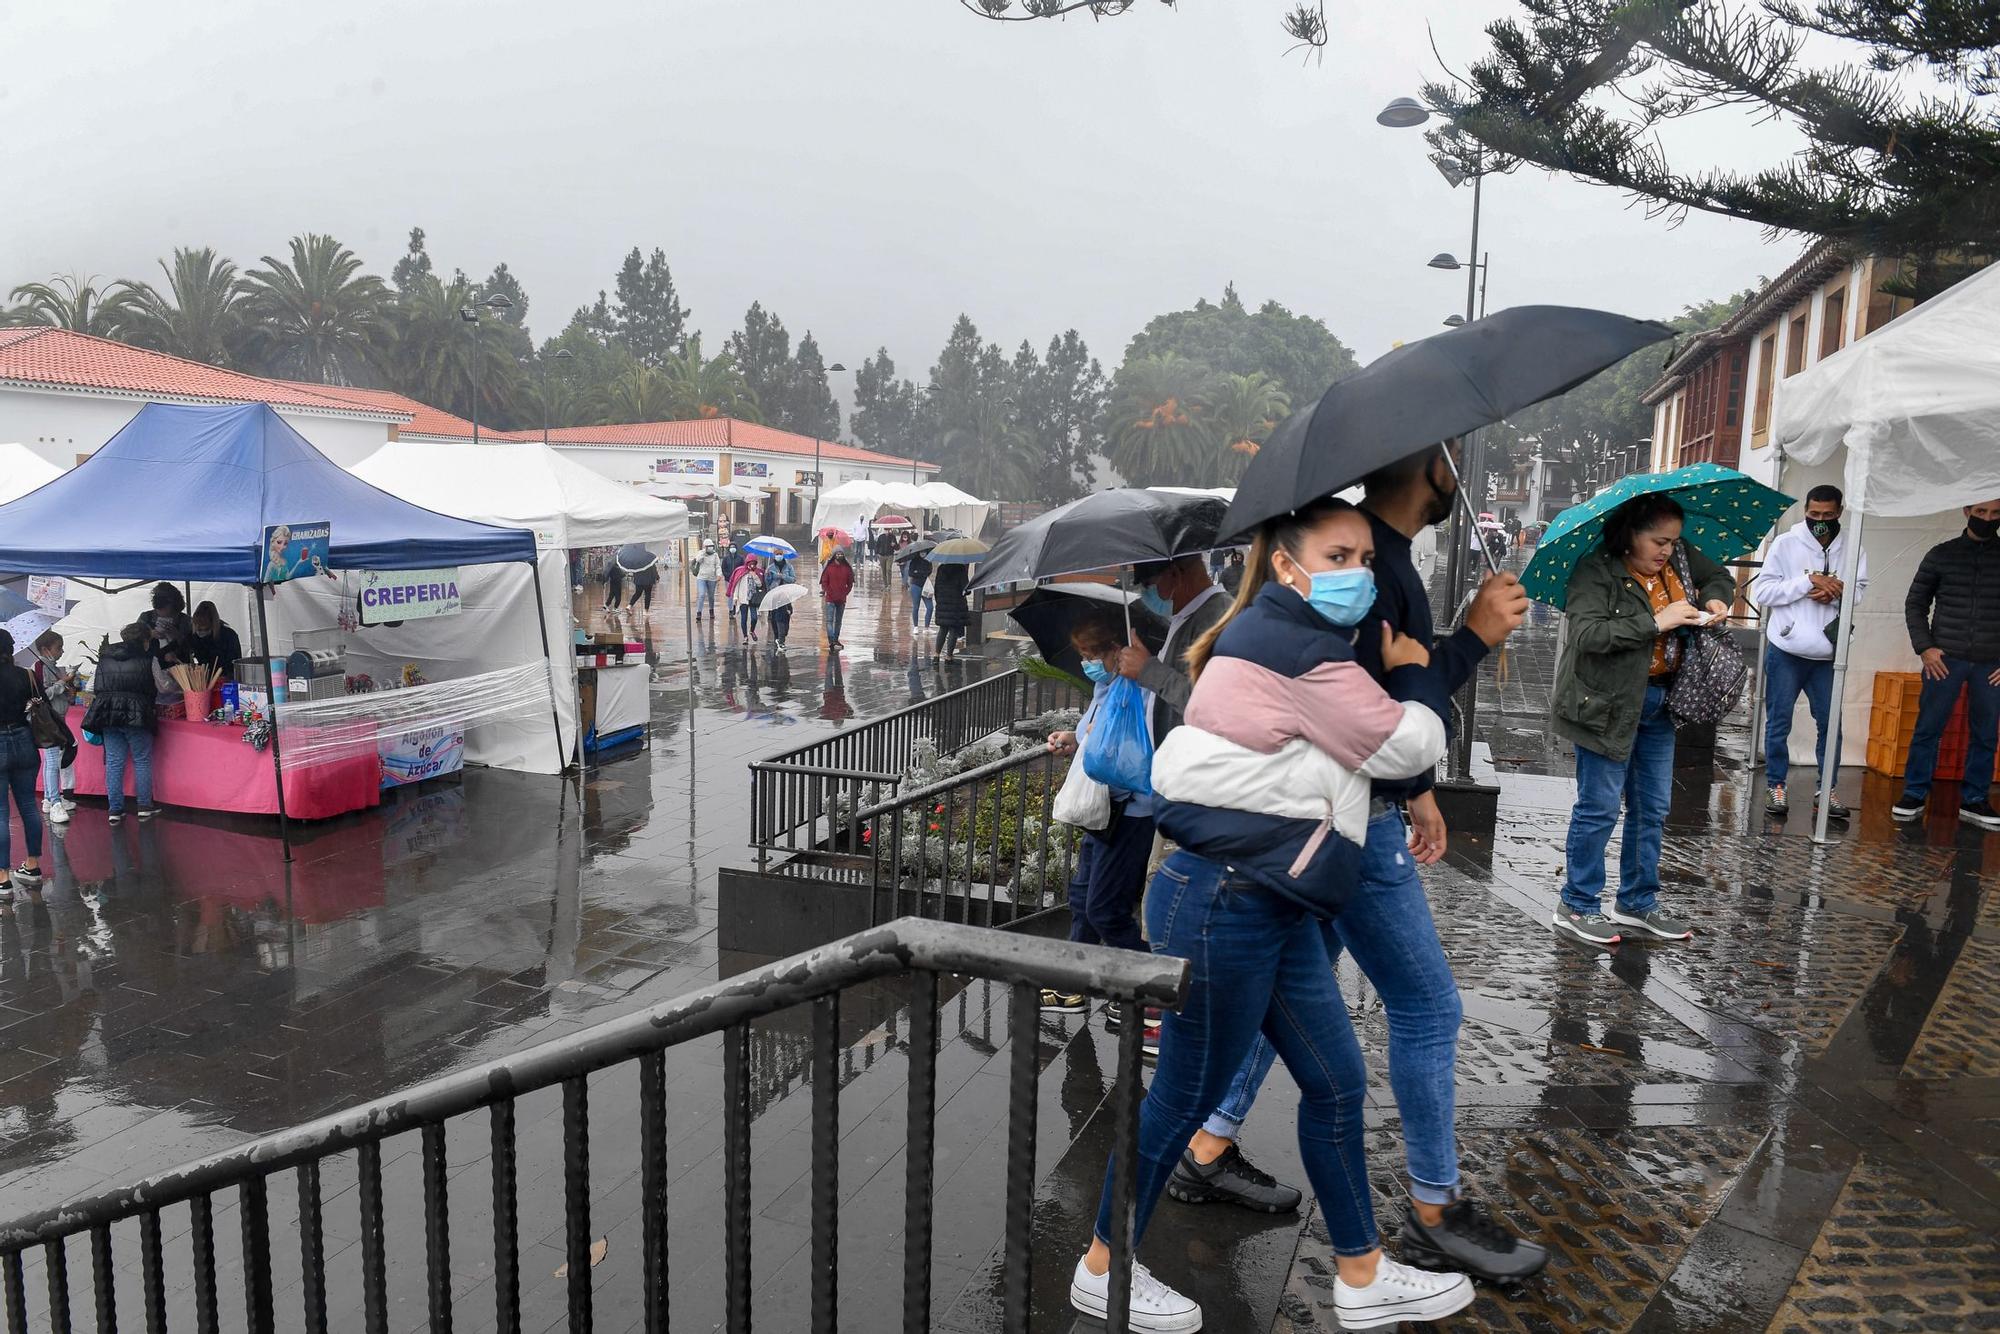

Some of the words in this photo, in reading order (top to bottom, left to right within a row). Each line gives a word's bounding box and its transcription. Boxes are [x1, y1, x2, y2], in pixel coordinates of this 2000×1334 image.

[291, 527, 329, 540] GRANIZADAS
[363, 582, 460, 607] CREPERIA
[419, 744, 432, 758] de
